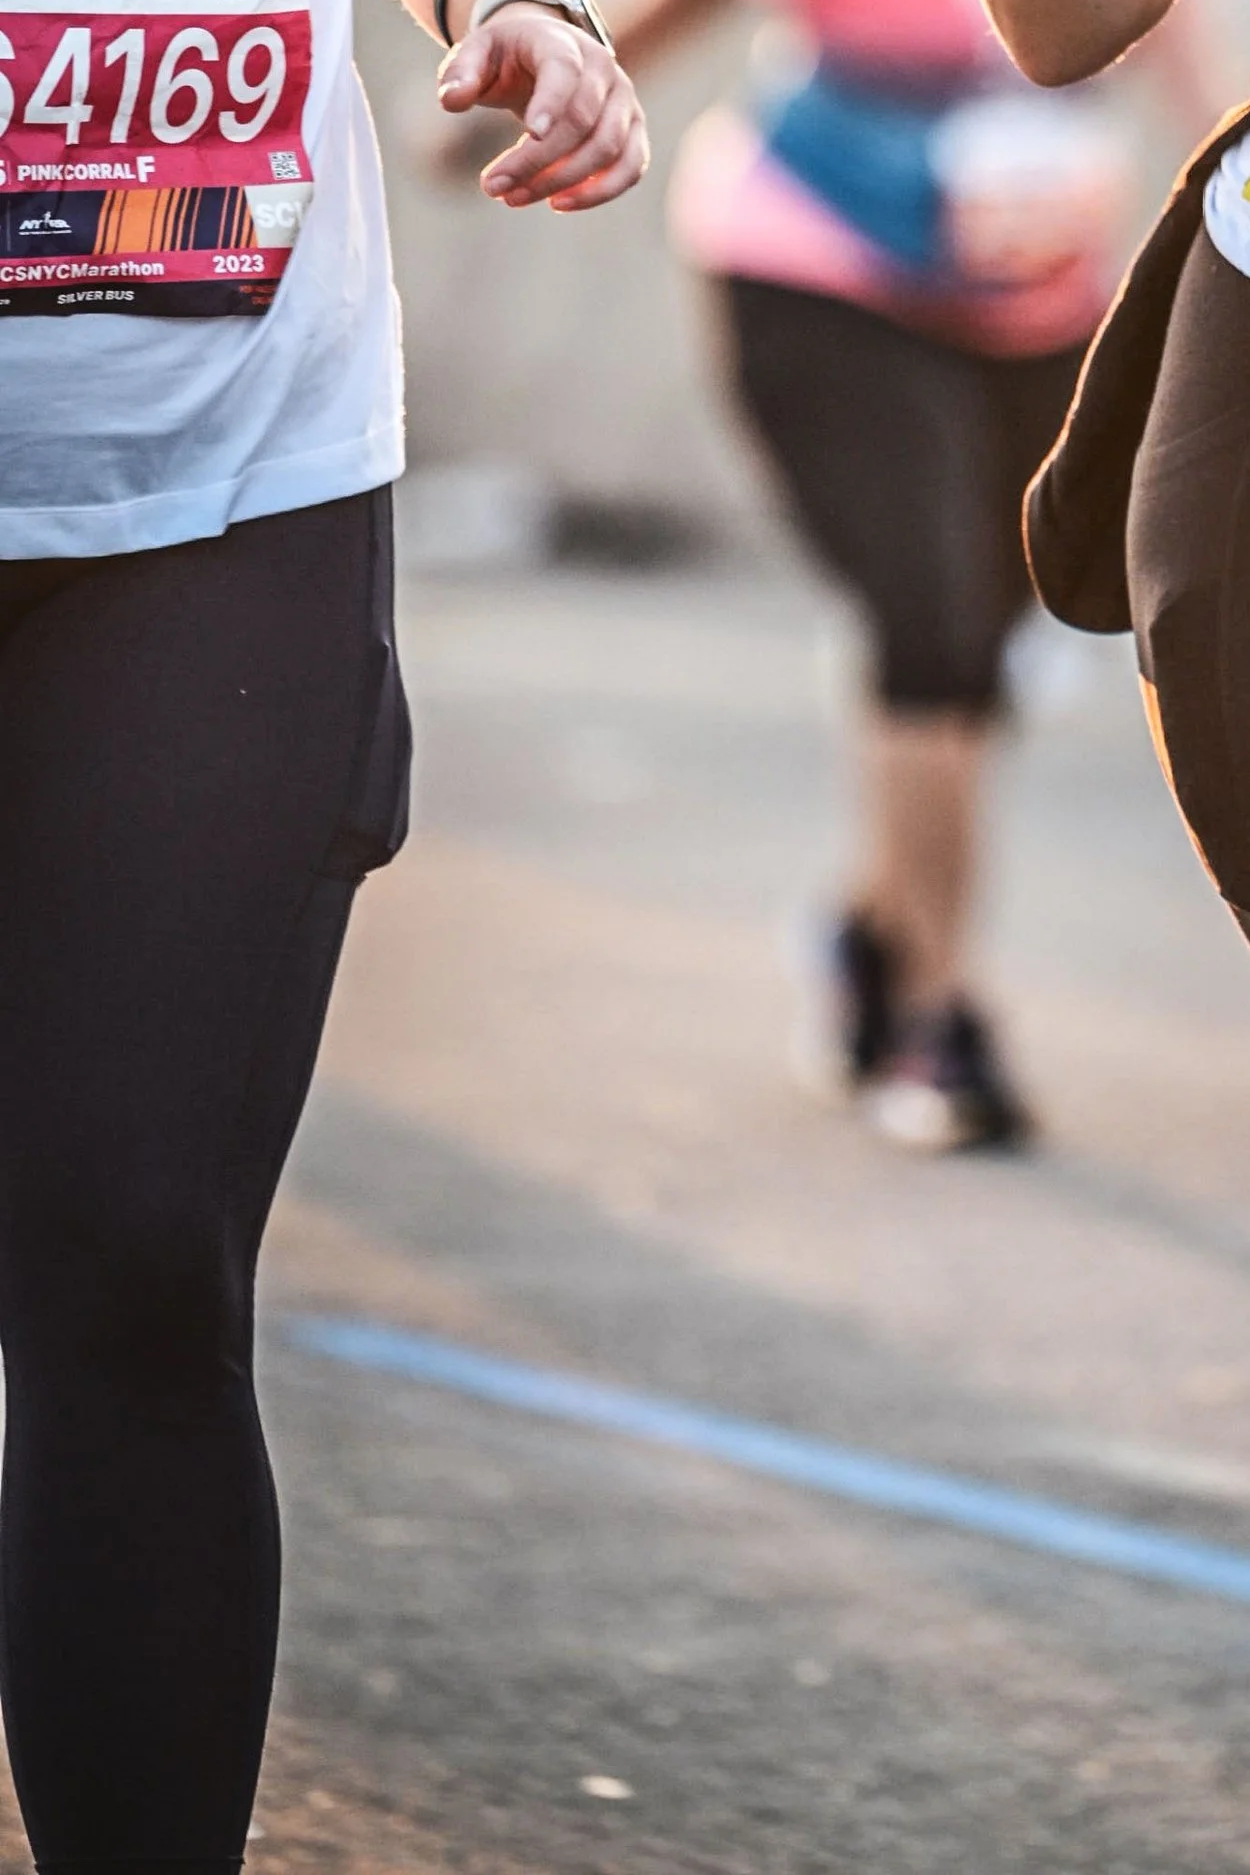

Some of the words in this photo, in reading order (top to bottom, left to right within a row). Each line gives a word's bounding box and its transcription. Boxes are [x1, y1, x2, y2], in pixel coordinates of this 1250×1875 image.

[212, 254, 264, 273] 2023
[57, 291, 103, 305] SILVER
[105, 290, 135, 301] BUS
